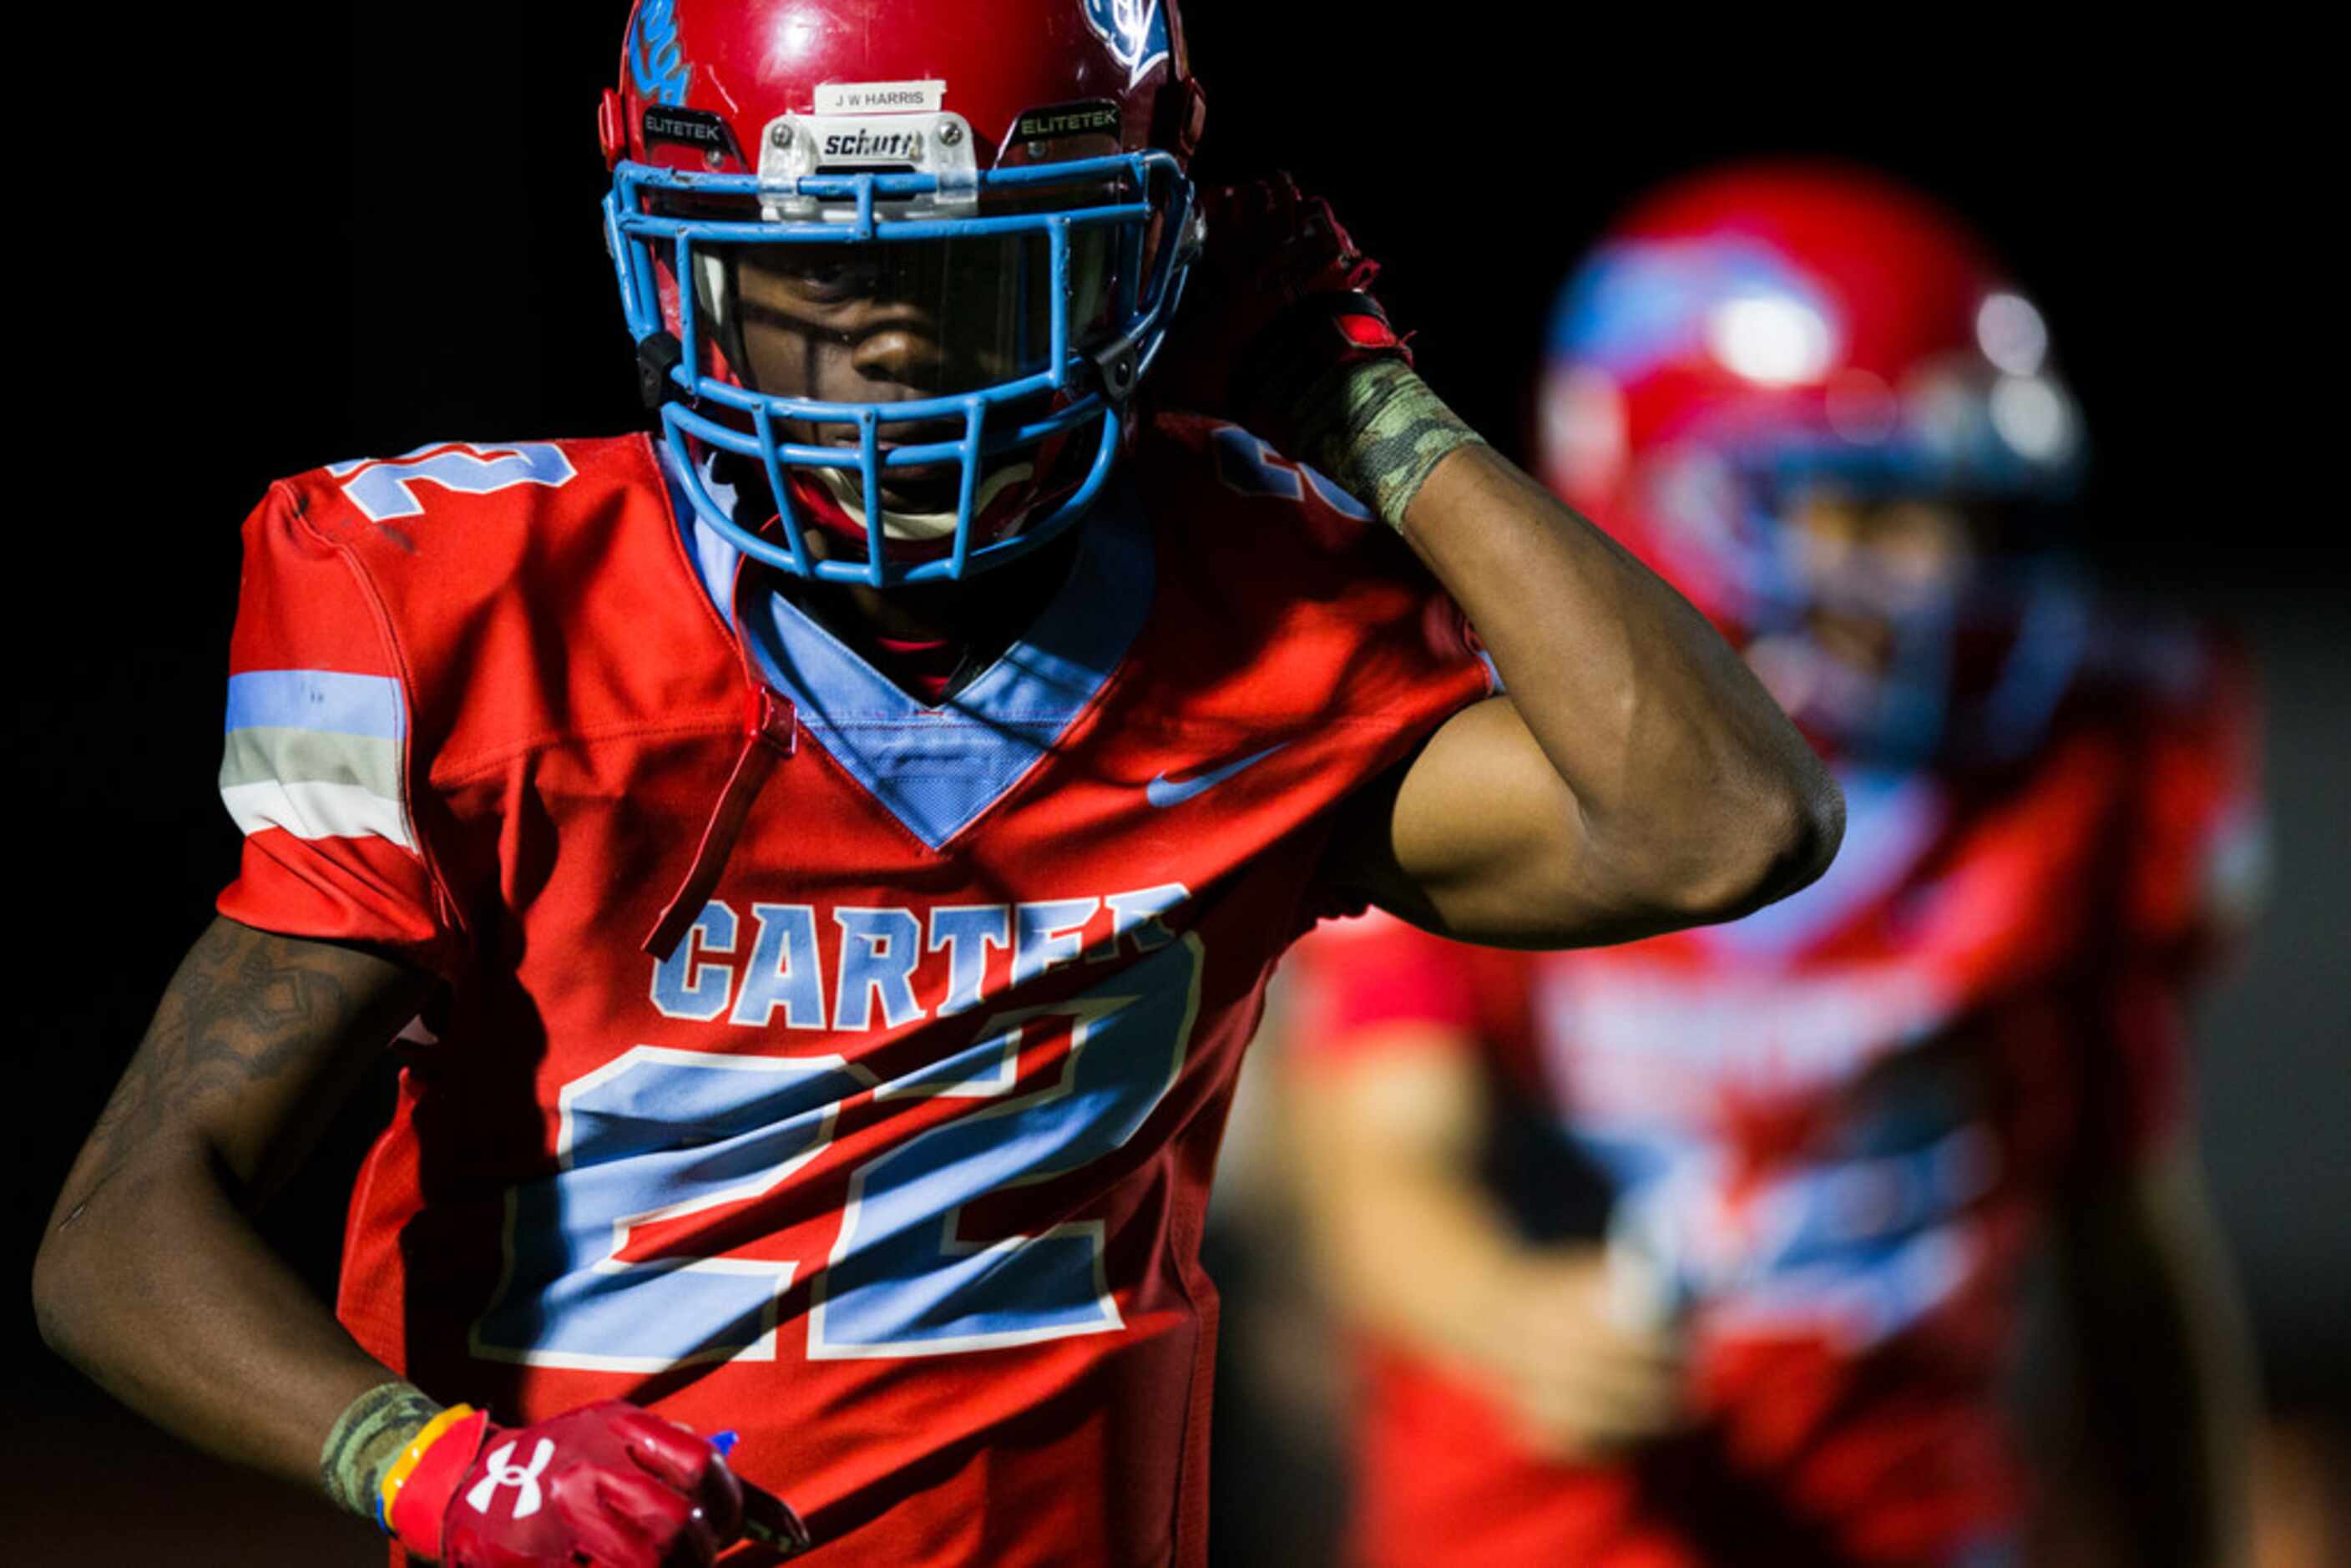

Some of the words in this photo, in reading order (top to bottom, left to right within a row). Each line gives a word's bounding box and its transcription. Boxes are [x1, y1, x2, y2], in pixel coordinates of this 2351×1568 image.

[835, 95, 843, 107] J
[848, 94, 860, 106] W
[865, 91, 924, 105] HARRIS
[645, 115, 720, 140] ELITETEK
[1021, 109, 1116, 135] ELITETEK
[650, 883, 1192, 1032] CARTER
[469, 930, 1204, 1373] 22
